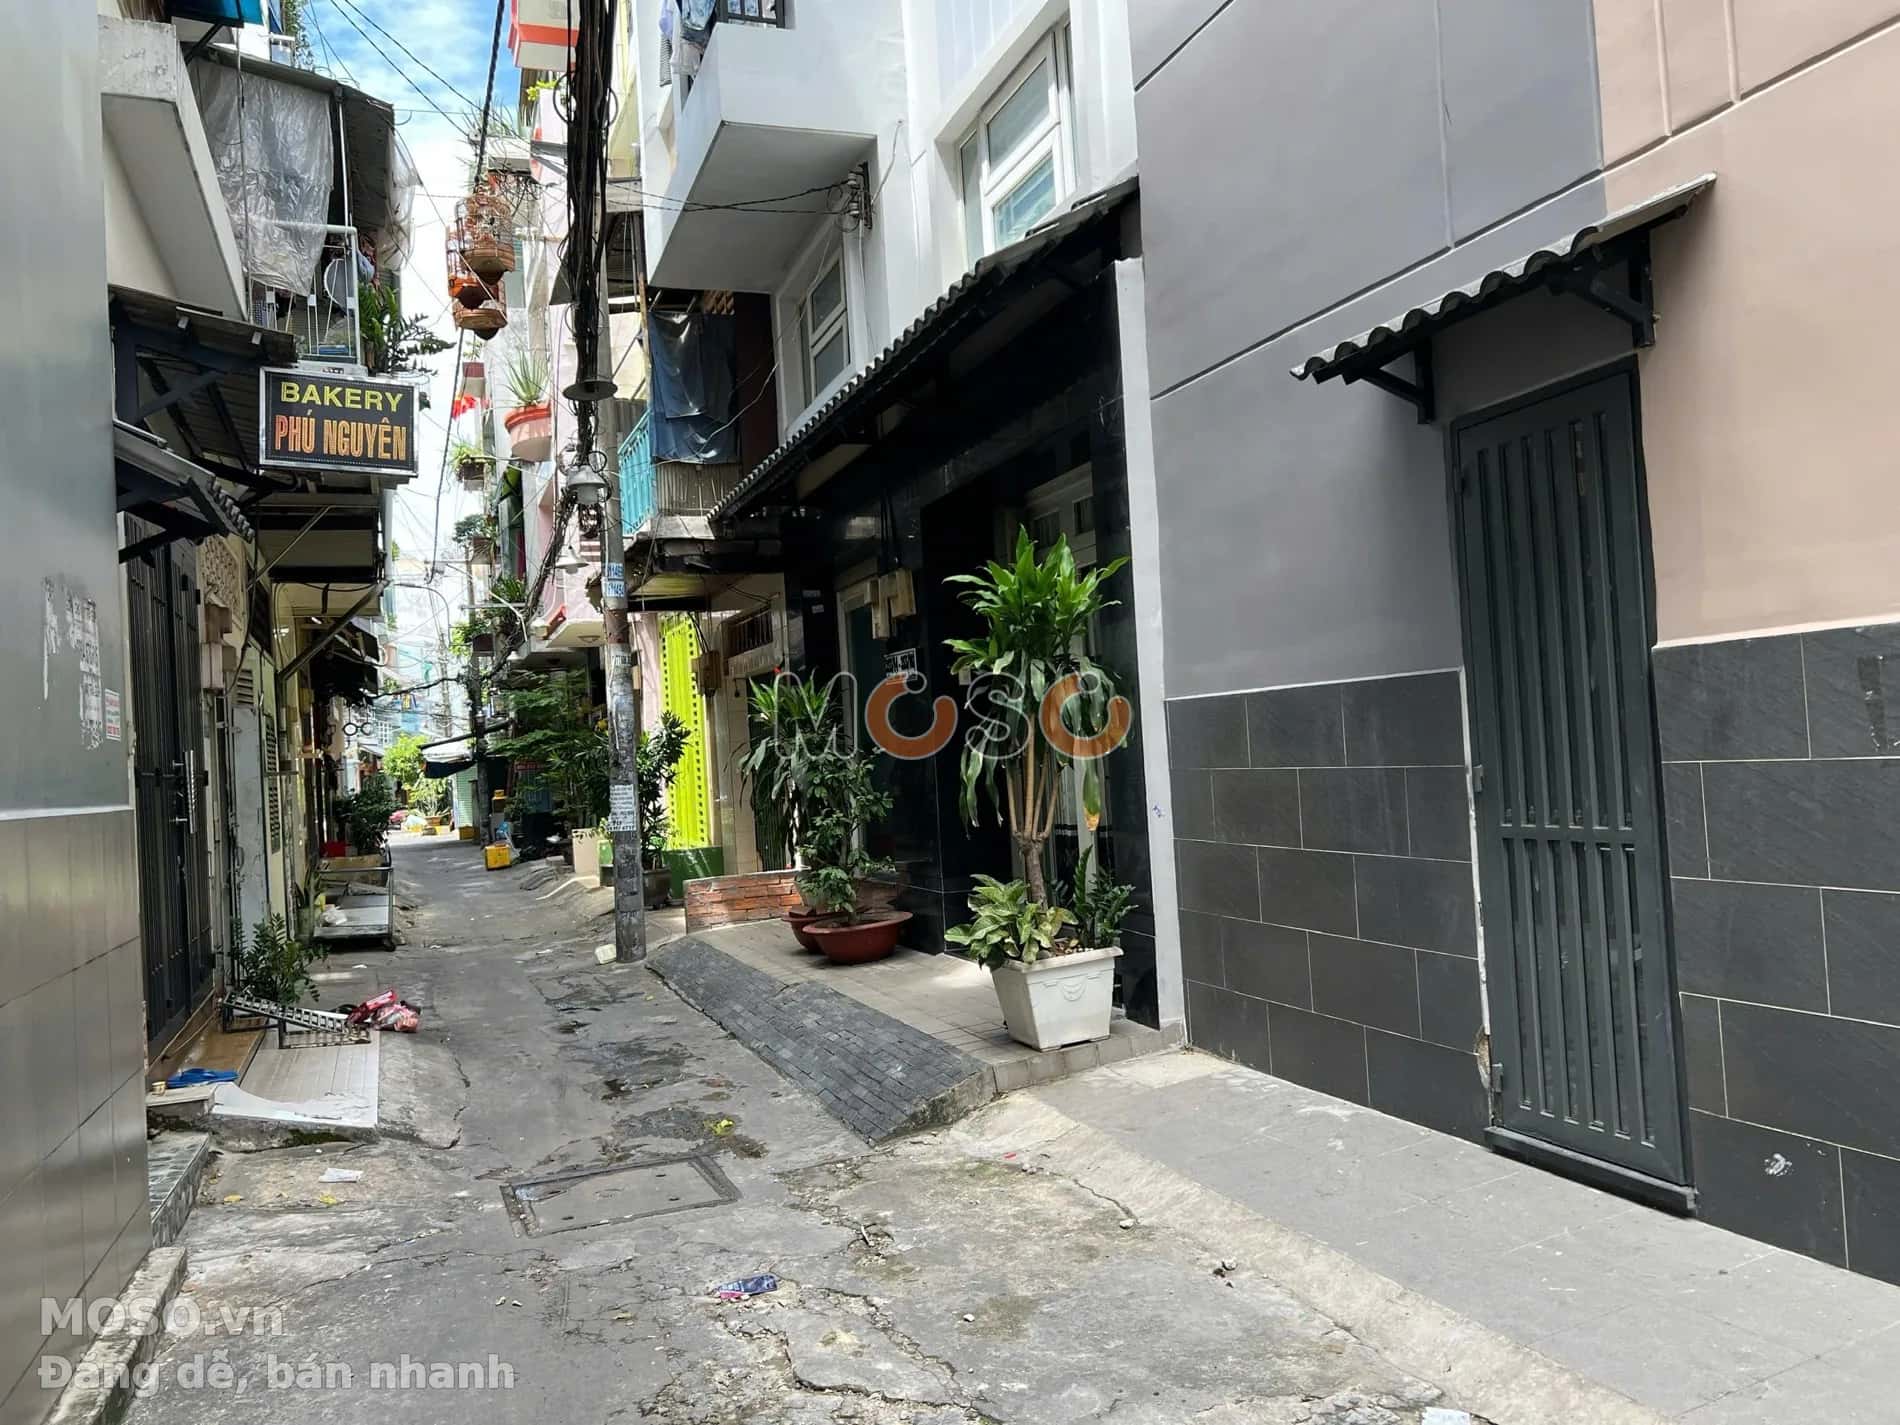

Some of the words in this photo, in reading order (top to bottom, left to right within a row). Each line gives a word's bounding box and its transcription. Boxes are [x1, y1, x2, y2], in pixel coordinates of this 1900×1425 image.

[281, 381, 403, 412] BAKERY
[274, 409, 316, 454] PHÚ
[323, 417, 407, 461] NGUYÊN
